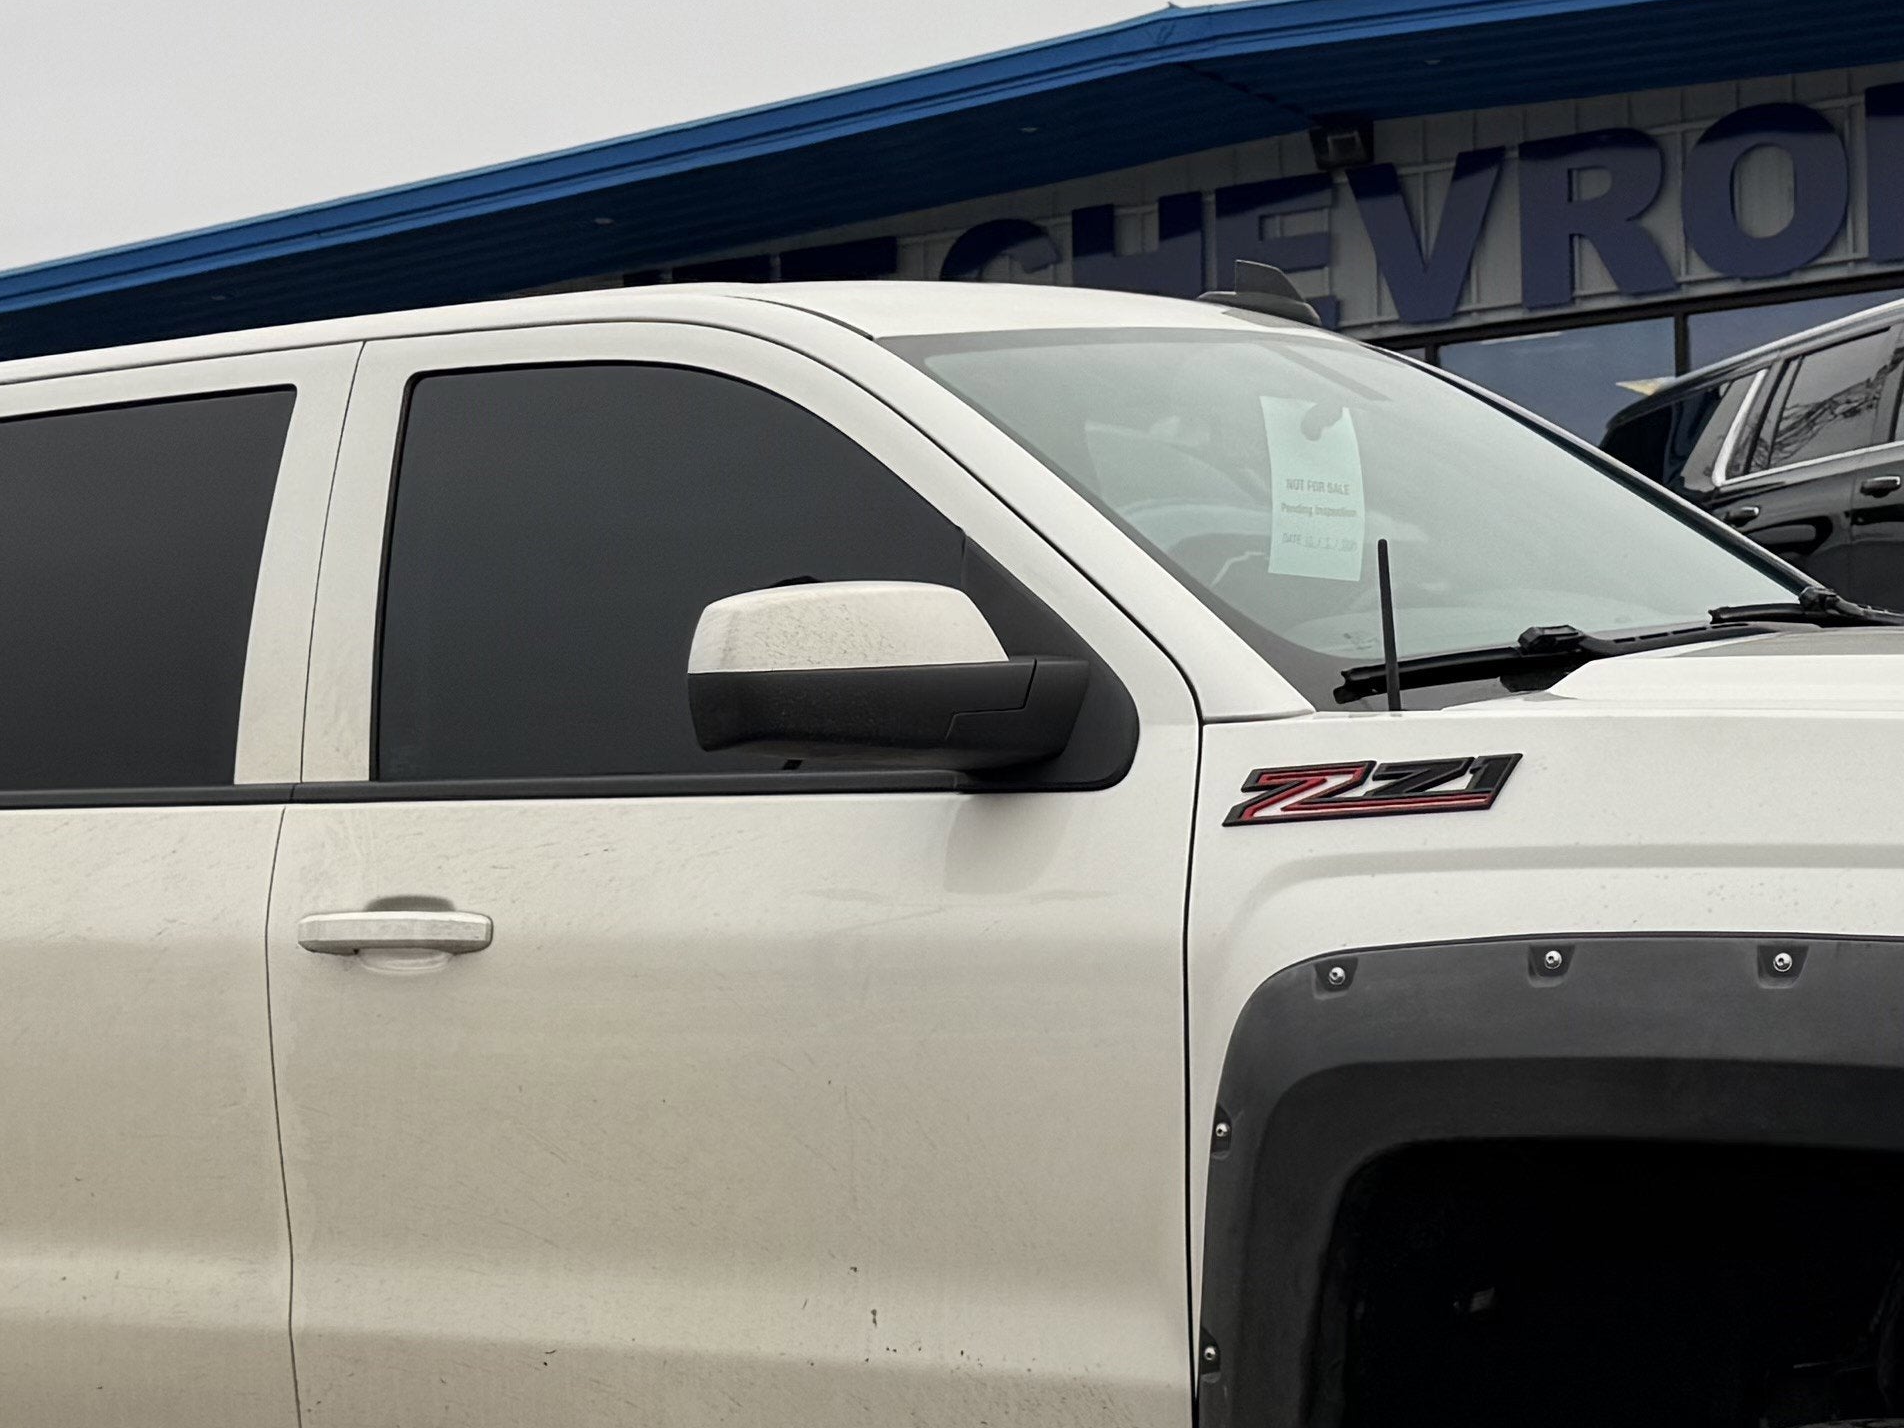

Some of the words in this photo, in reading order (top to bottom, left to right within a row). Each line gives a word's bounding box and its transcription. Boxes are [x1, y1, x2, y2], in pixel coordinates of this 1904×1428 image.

[1286, 478, 1304, 491] NOT
[1307, 479, 1325, 493] FOR
[1327, 481, 1350, 495] SALE
